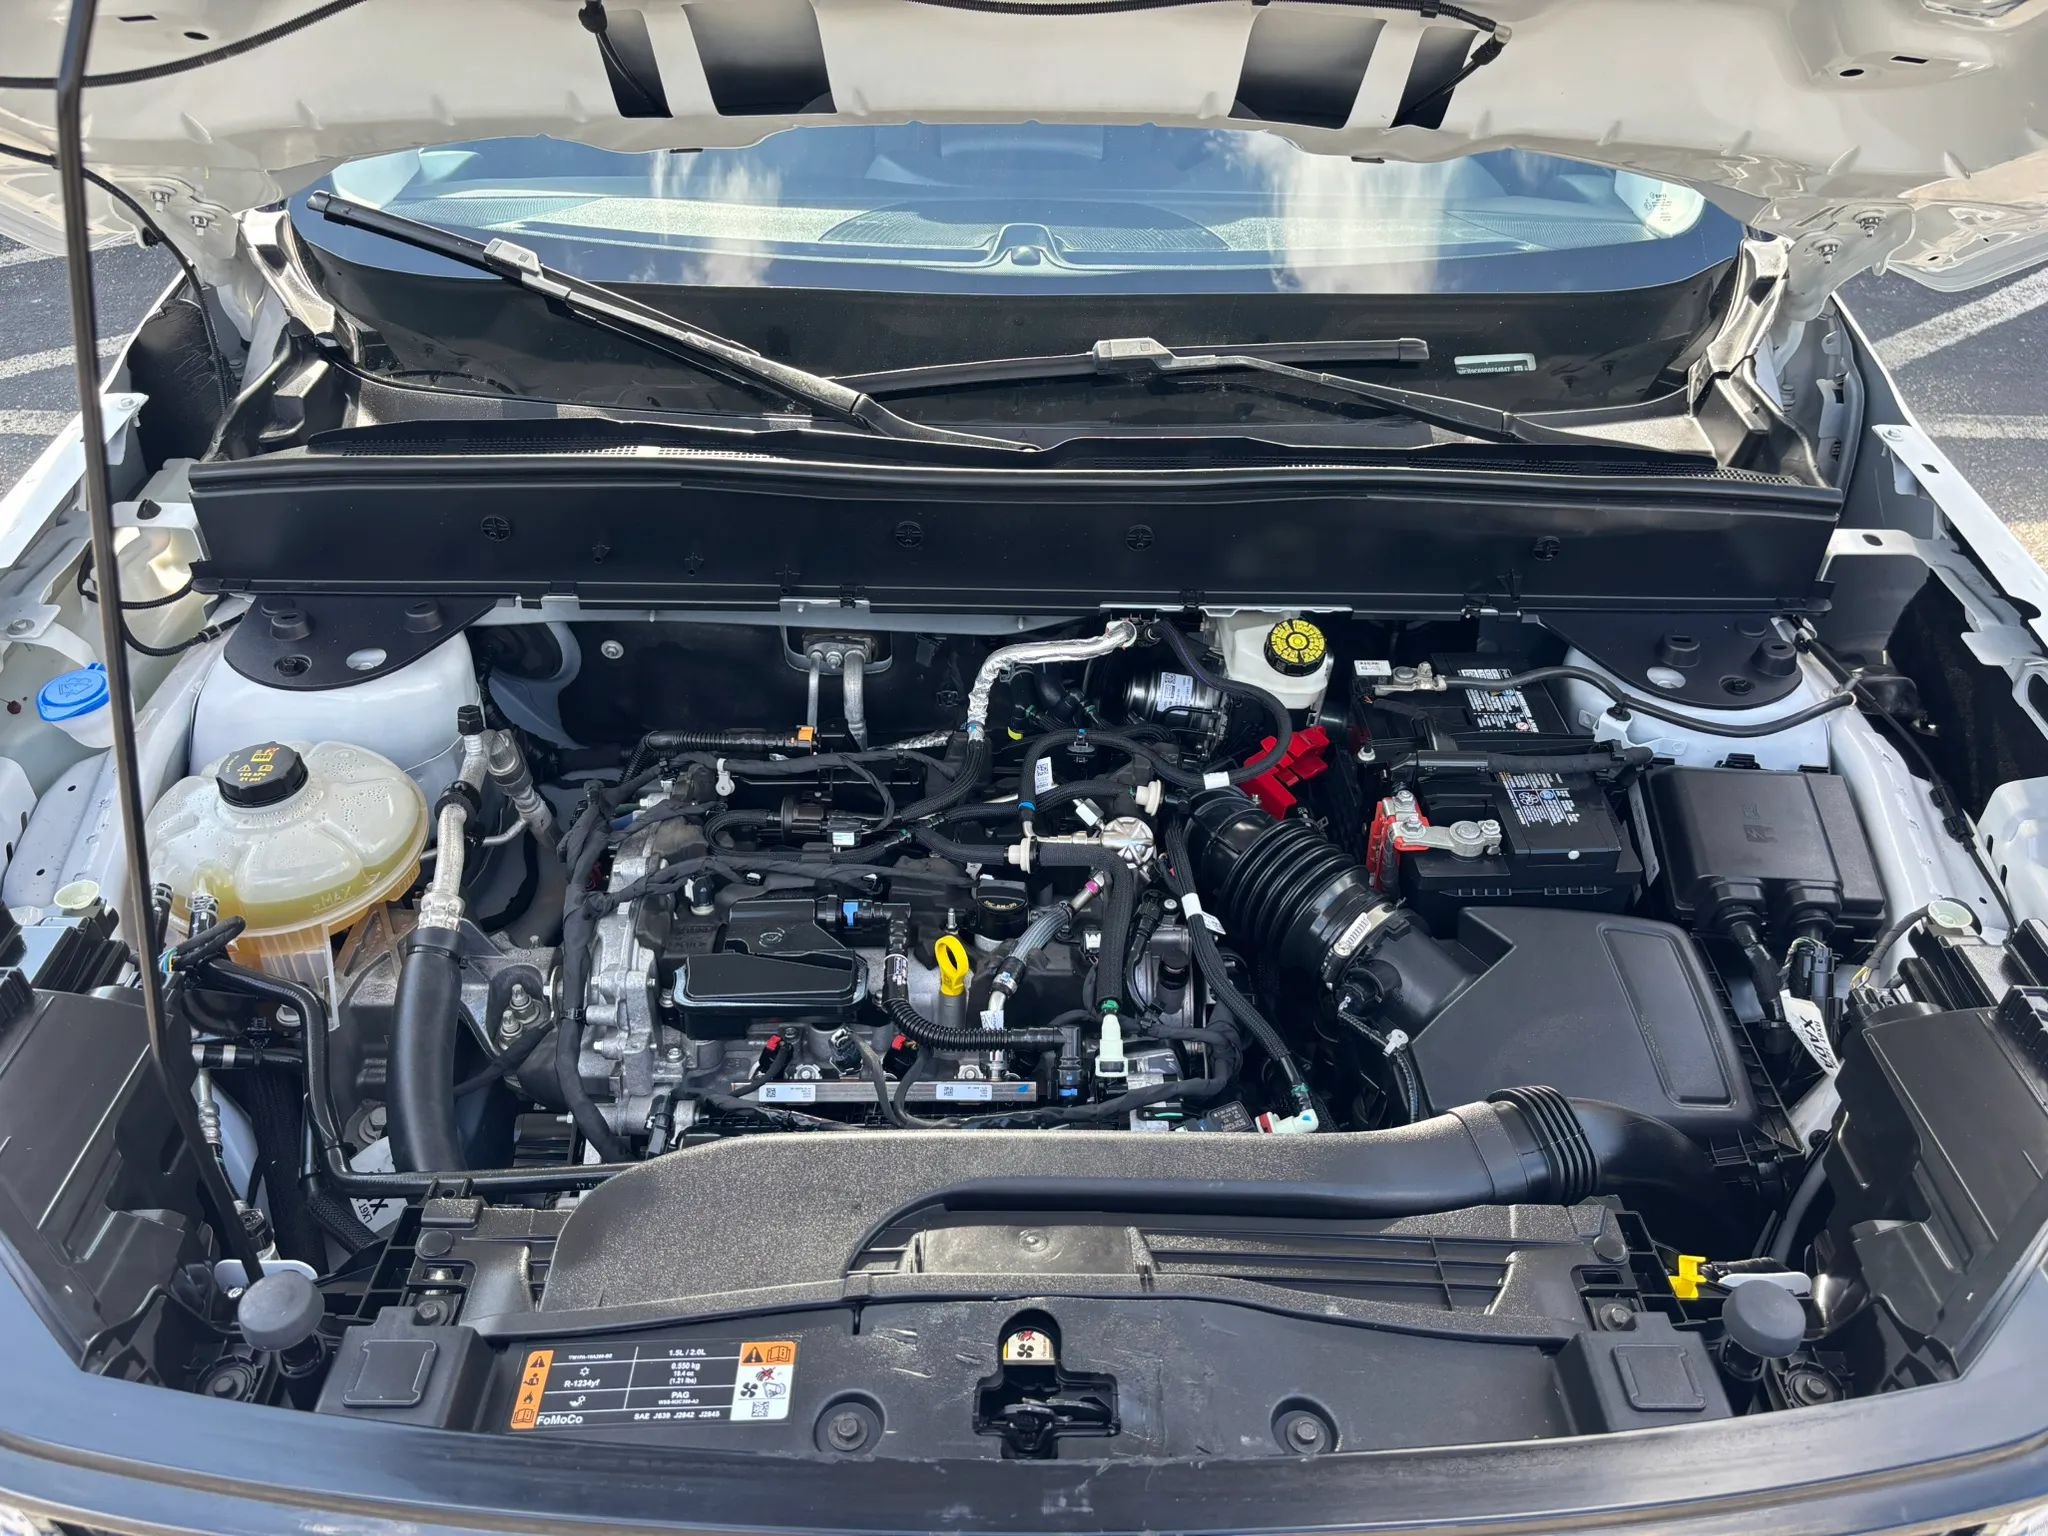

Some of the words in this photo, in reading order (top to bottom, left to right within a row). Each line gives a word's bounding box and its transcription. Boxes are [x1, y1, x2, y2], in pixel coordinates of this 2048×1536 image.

[358, 1203, 373, 1224] LX6T
[668, 1348, 684, 1356] 1.5L
[690, 1348, 706, 1356] 2.0L
[691, 1362, 701, 1371] kg
[563, 1379, 601, 1389] R-1234yf
[536, 1414, 584, 1426] FoMoCo
